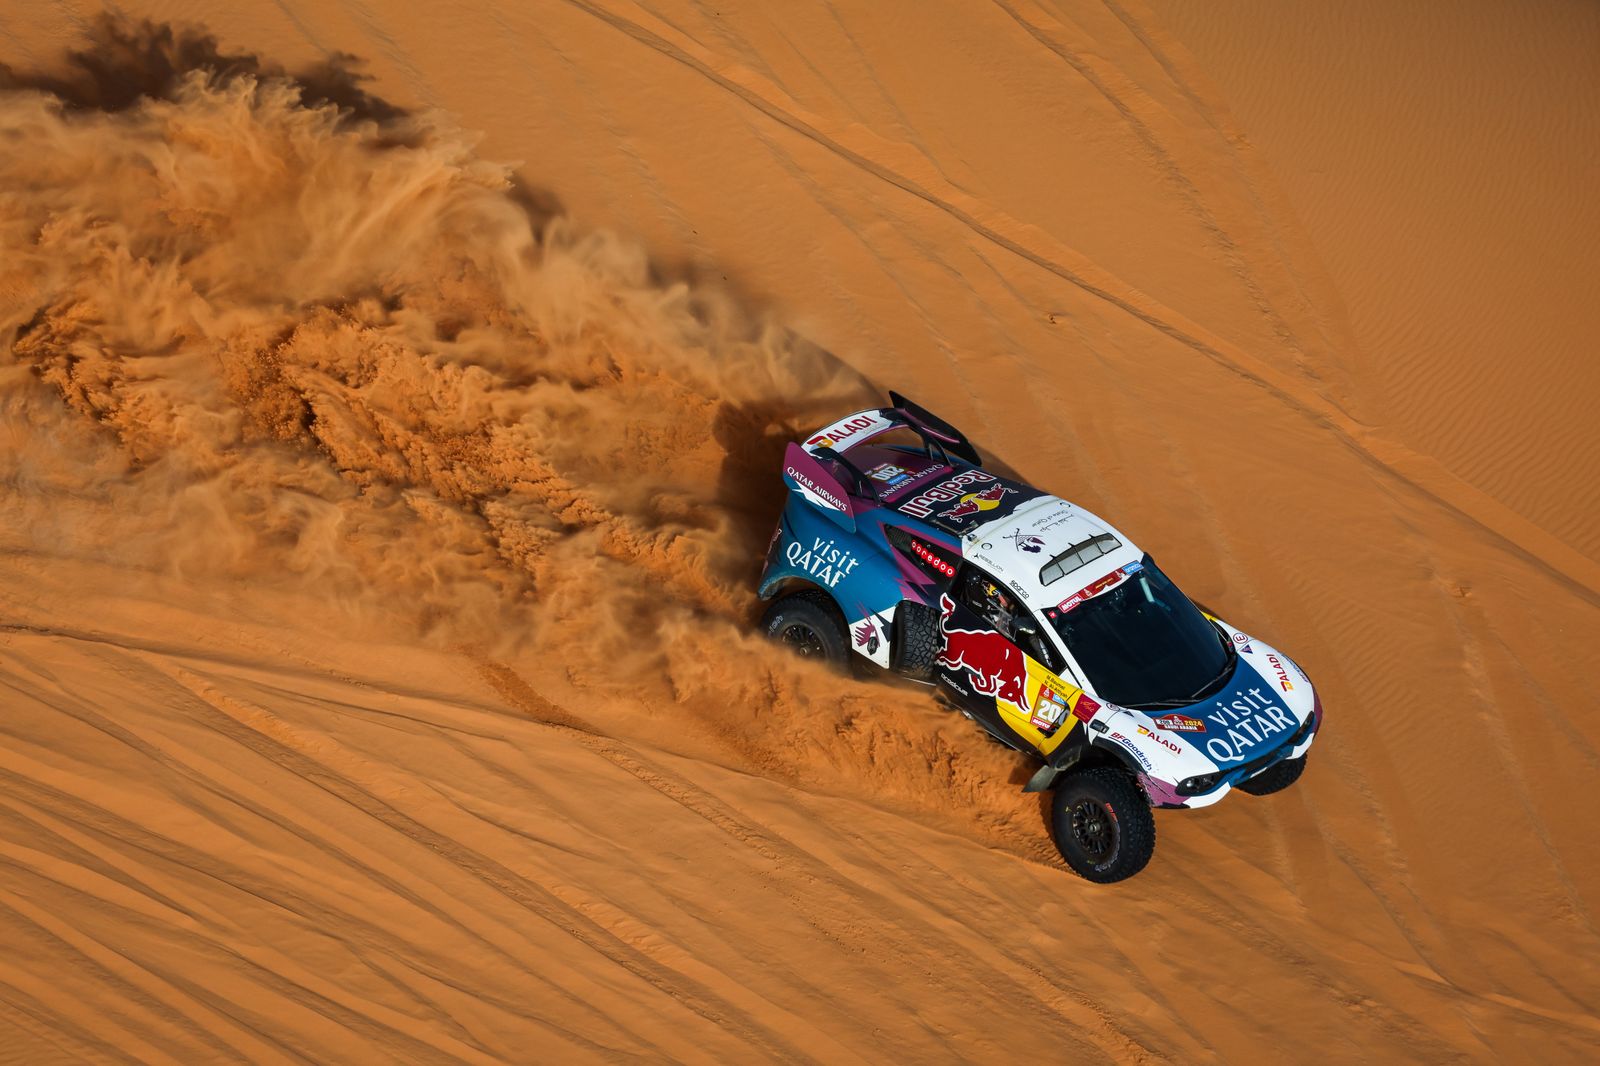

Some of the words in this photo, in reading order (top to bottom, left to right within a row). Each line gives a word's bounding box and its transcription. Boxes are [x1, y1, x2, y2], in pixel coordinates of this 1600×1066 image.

[787, 466, 815, 491] QATAR
[814, 485, 848, 512] AIRWAYS
[879, 474, 917, 499] AIRWAYS
[812, 537, 859, 575] visit
[912, 541, 955, 576] ooredoo
[1009, 580, 1030, 599] sparco
[1060, 595, 1082, 611] MOTUL
[1032, 718, 1052, 729] MOTU
[1207, 687, 1273, 727] visit
[1110, 732, 1154, 772] BFGoodrich
[1206, 706, 1298, 764] QATAR
